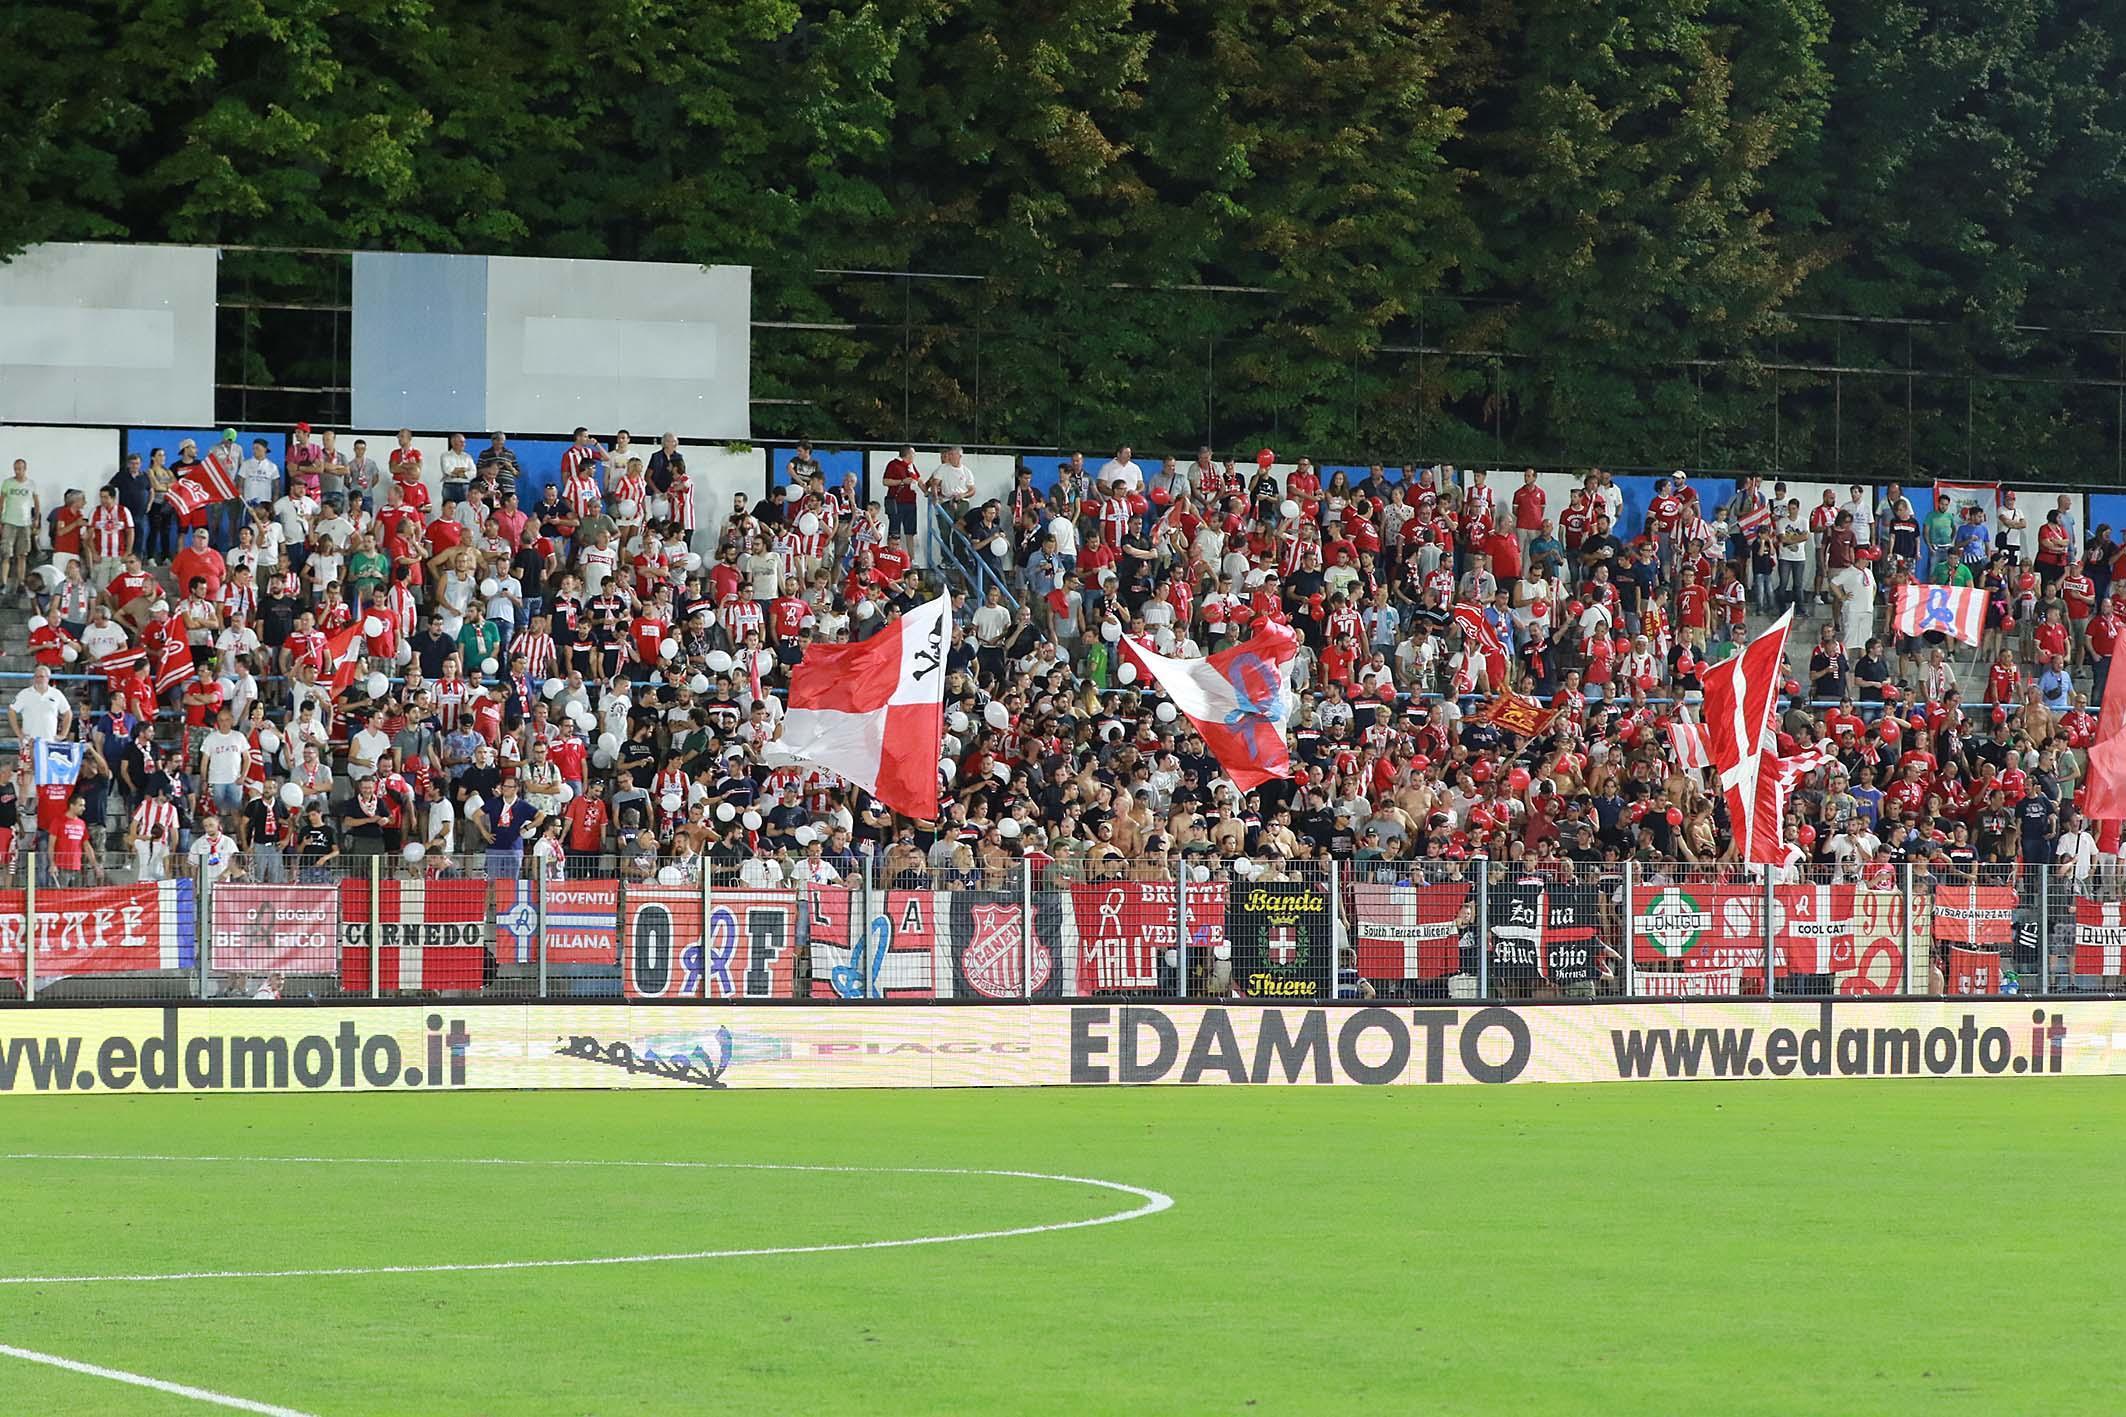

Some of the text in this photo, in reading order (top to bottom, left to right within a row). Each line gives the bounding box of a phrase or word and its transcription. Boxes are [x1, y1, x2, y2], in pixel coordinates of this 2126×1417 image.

[1244, 888, 1324, 913] Banda
[1363, 925, 1387, 938] South
[1390, 927, 1421, 938] Terrace
[1644, 914, 1702, 932] LONIGO
[1798, 924, 1846, 935] COOL CAT
[1246, 973, 1318, 997] Thiene
[1071, 1007, 1532, 1084] EDAMOTO
[1611, 1000, 2067, 1077] www.edamoto.it
